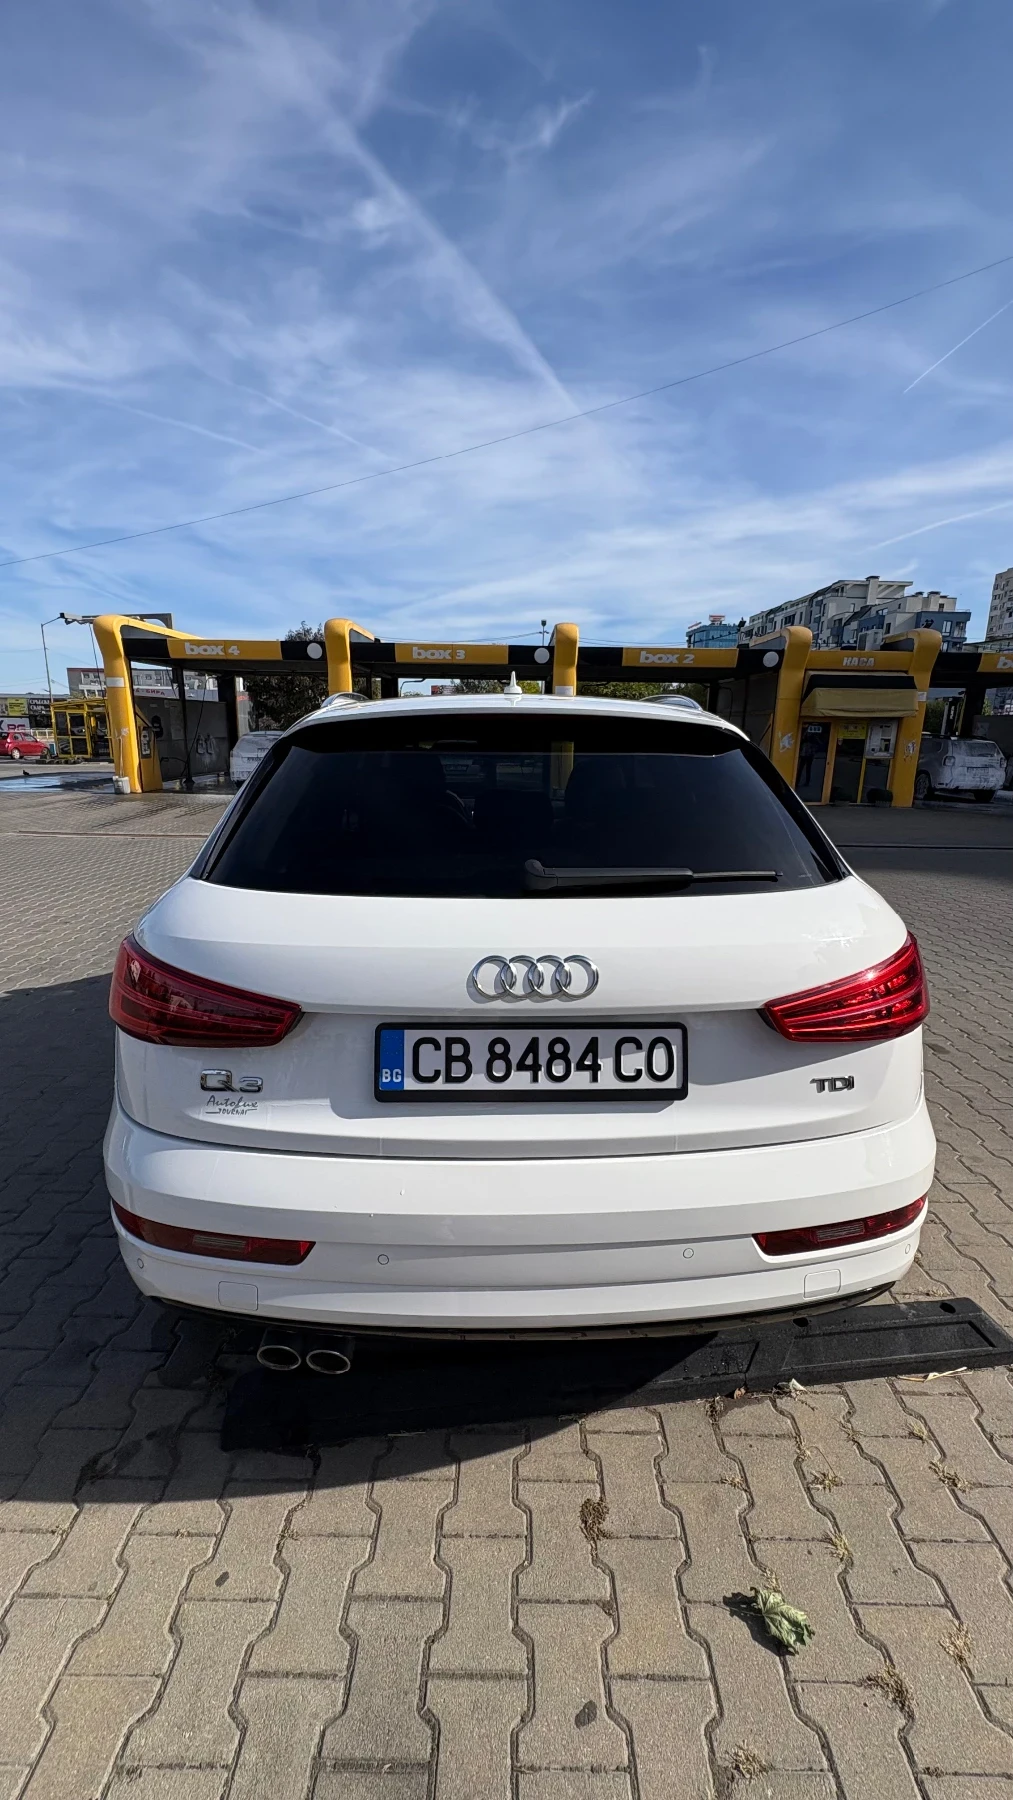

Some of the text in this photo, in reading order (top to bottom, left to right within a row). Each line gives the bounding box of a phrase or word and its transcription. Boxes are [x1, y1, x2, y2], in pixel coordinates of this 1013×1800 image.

[185, 642, 240, 656] box 4
[412, 646, 466, 659] box 3
[640, 651, 695, 664] box 2
[411, 1037, 676, 1084] CB 8484 CO
[200, 1068, 264, 1093] Q3
[381, 1069, 402, 1083] BG
[809, 1075, 855, 1093] TDI
